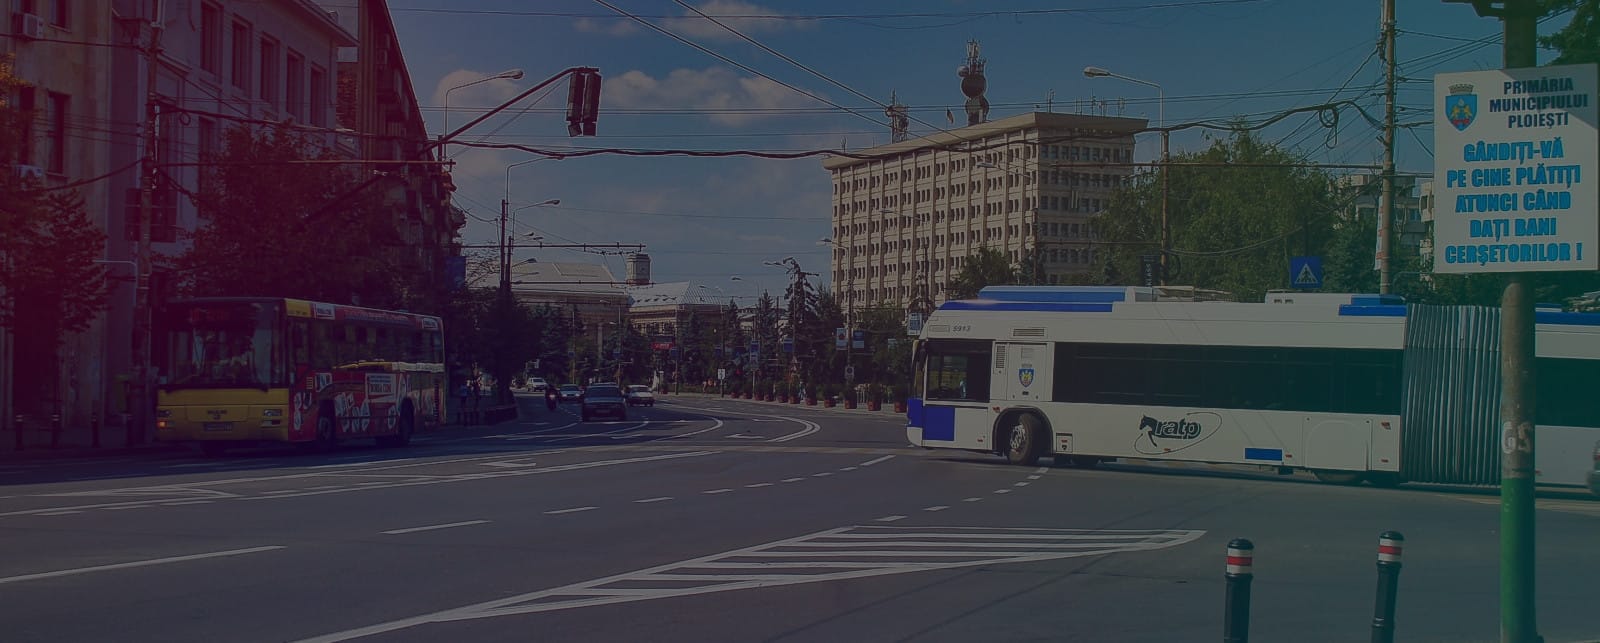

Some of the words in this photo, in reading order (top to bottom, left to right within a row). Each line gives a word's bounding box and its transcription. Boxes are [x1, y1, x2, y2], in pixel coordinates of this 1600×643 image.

[1503, 77, 1574, 95] PRIMĂRIA
[1489, 94, 1588, 112] MUNICIPIULUI
[1446, 169, 1467, 188] PE
[1471, 168, 1511, 187] CINE
[1455, 193, 1518, 213] ATUNCI
[1523, 188, 1572, 211] CÂND
[1515, 217, 1557, 237] BANI
[1576, 243, 1583, 261] !
[1155, 417, 1202, 441] ratp
